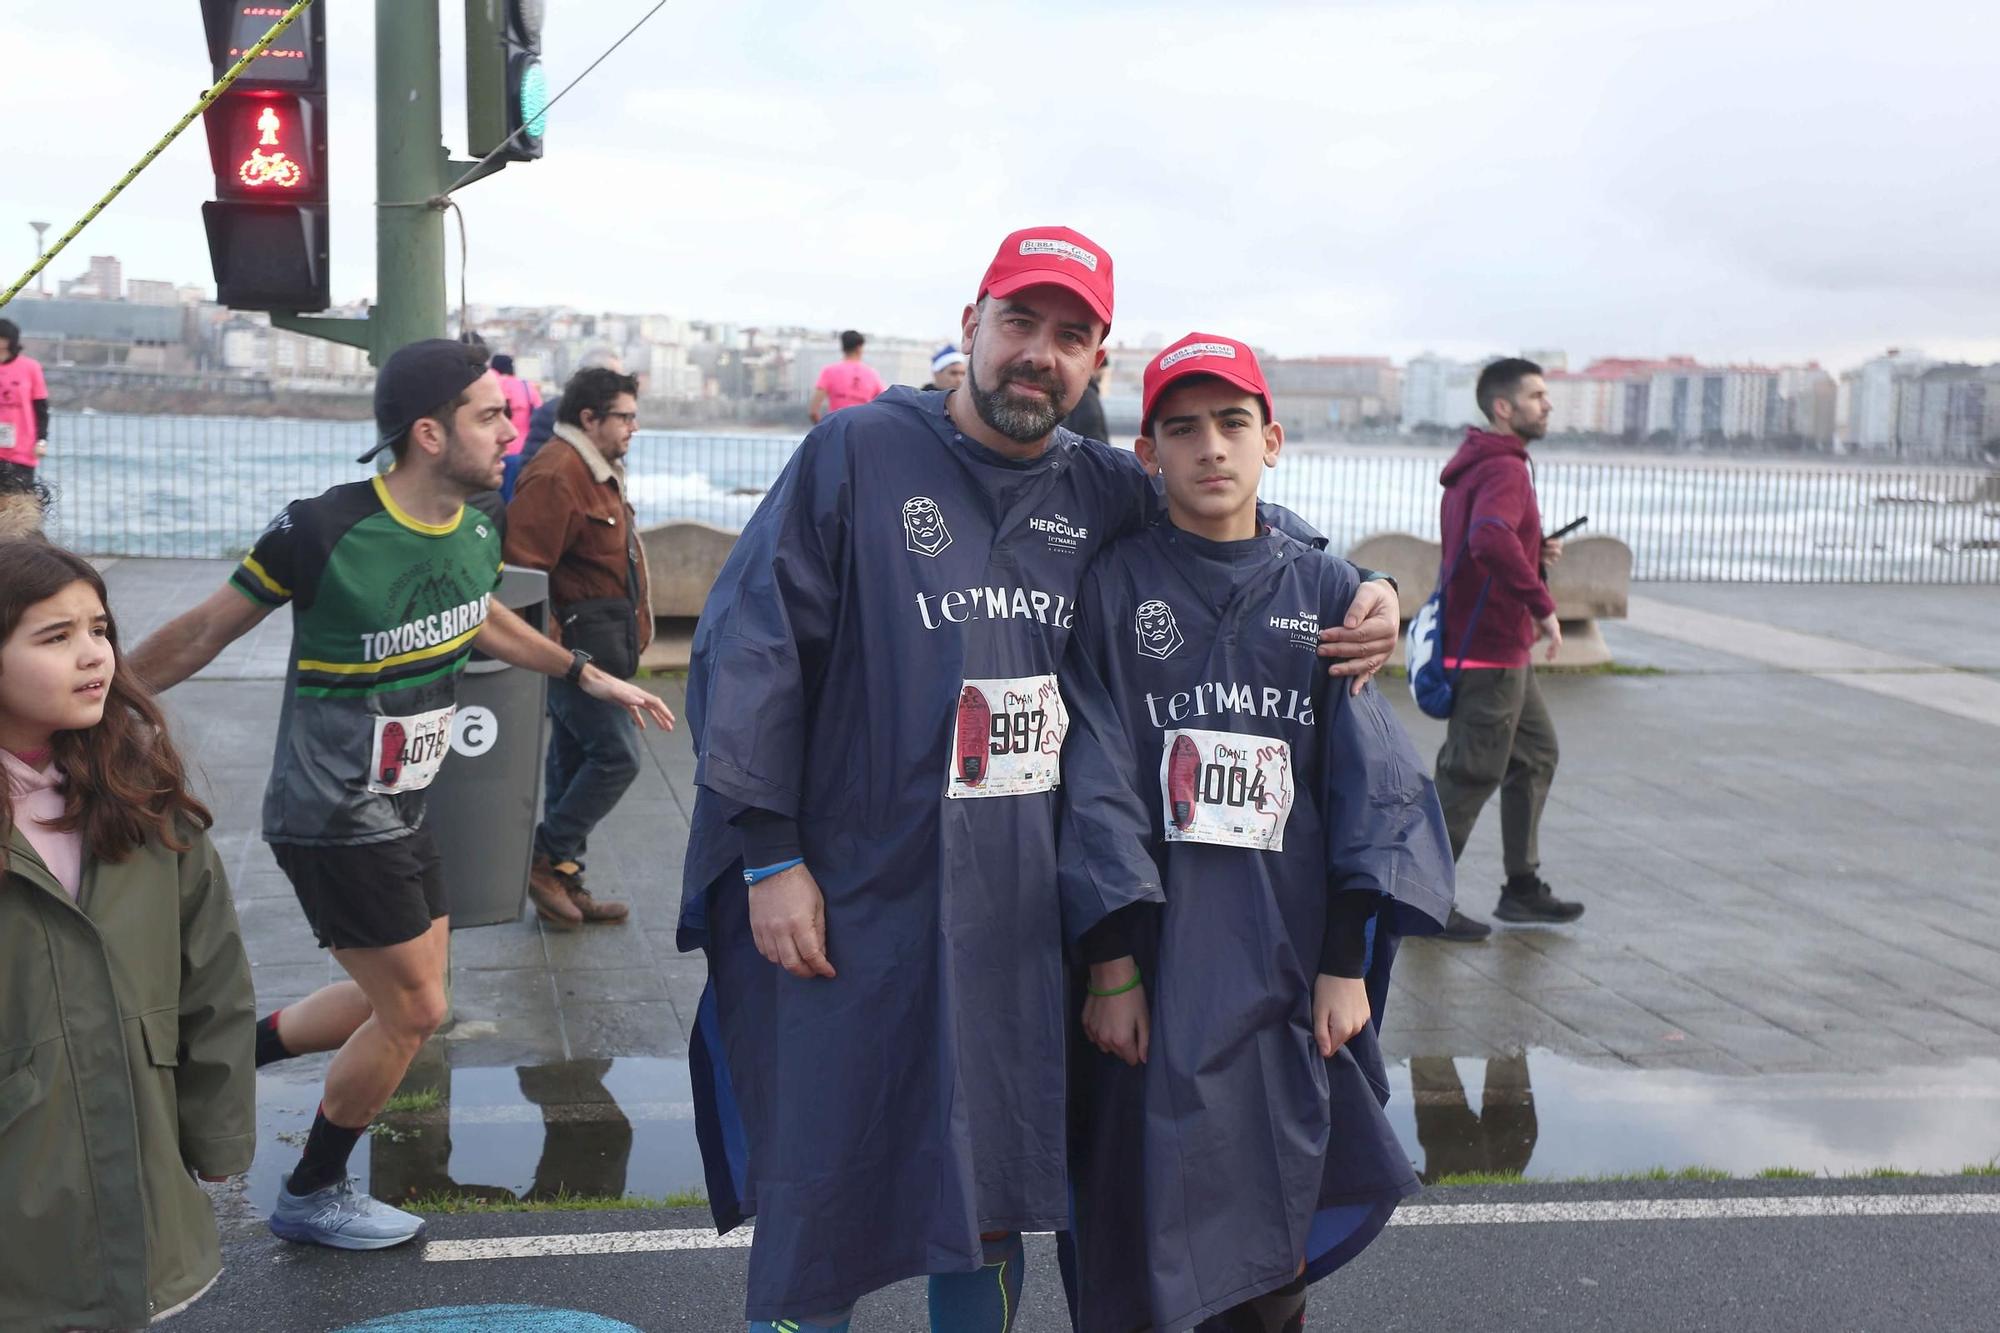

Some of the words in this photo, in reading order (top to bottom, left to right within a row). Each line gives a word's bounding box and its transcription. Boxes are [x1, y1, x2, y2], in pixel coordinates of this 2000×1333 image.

[1029, 517, 1088, 540] HERCULE
[1008, 694, 1033, 706] IVAN
[991, 709, 1044, 755] 997
[1218, 747, 1248, 761] DANI
